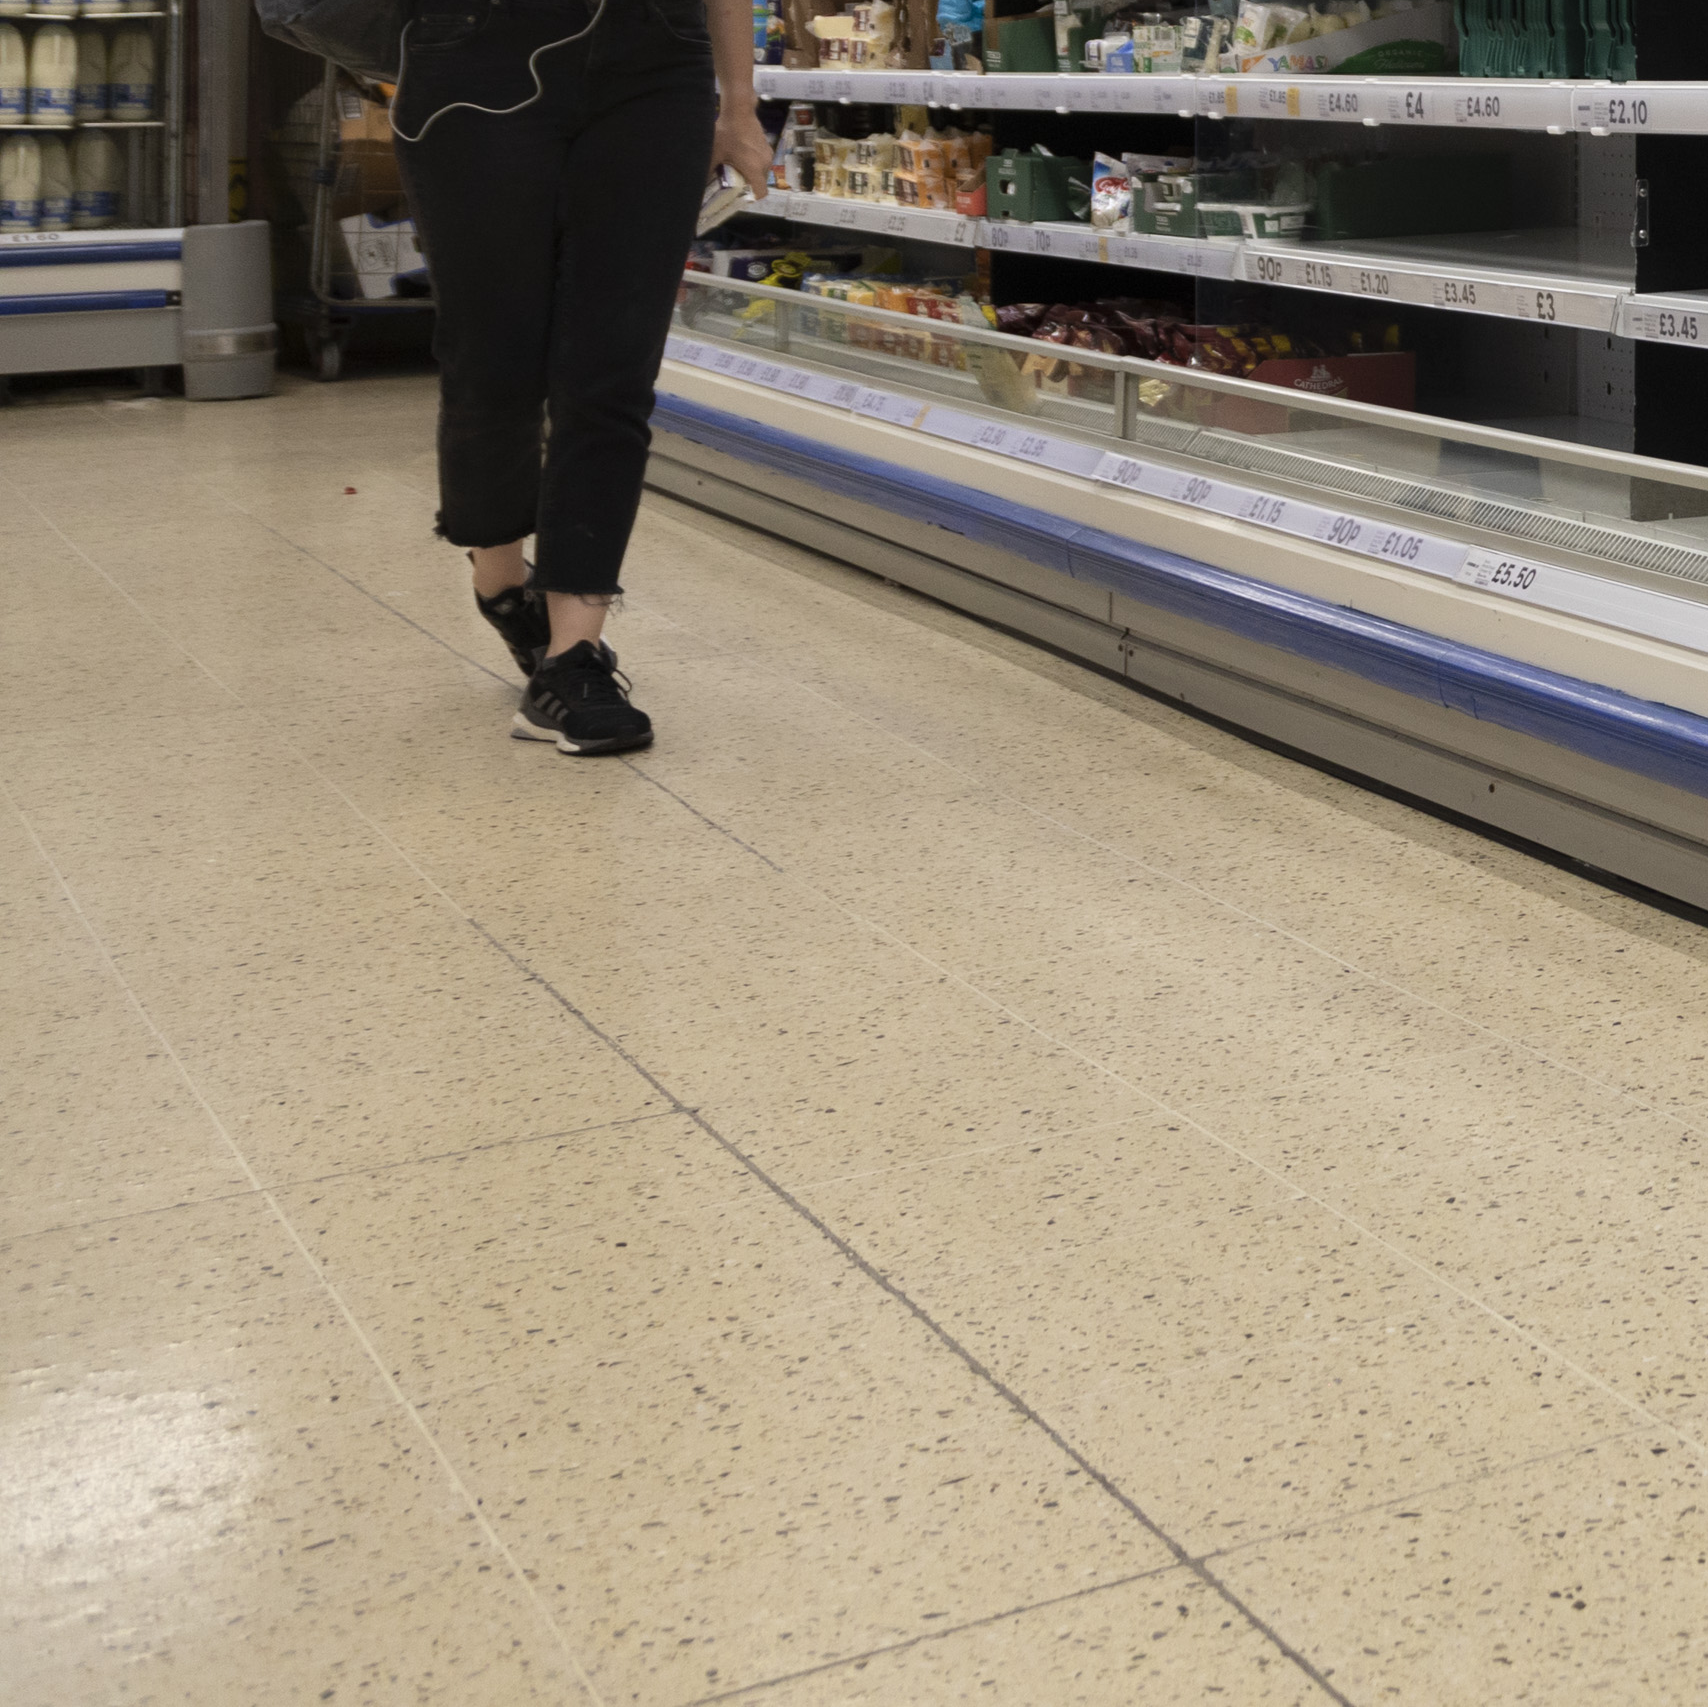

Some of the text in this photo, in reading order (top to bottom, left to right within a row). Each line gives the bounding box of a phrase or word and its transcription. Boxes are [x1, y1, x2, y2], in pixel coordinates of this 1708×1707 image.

[1406, 91, 1424, 120] £4
[1608, 100, 1648, 126] £2.10
[1256, 255, 1283, 284] 90p
[1305, 265, 1333, 288] £1.15
[1360, 271, 1389, 296] £1.20
[1444, 282, 1477, 306] £3.45
[1536, 291, 1556, 322] £3
[1658, 312, 1698, 342] £3.45
[1293, 372, 1345, 395] CATHEDRAL
[1182, 478, 1211, 504] 90p
[1248, 497, 1284, 525] £1.15
[1330, 517, 1361, 548] 90p
[1380, 531, 1424, 562] £1.05
[1490, 562, 1538, 592] £5.50
